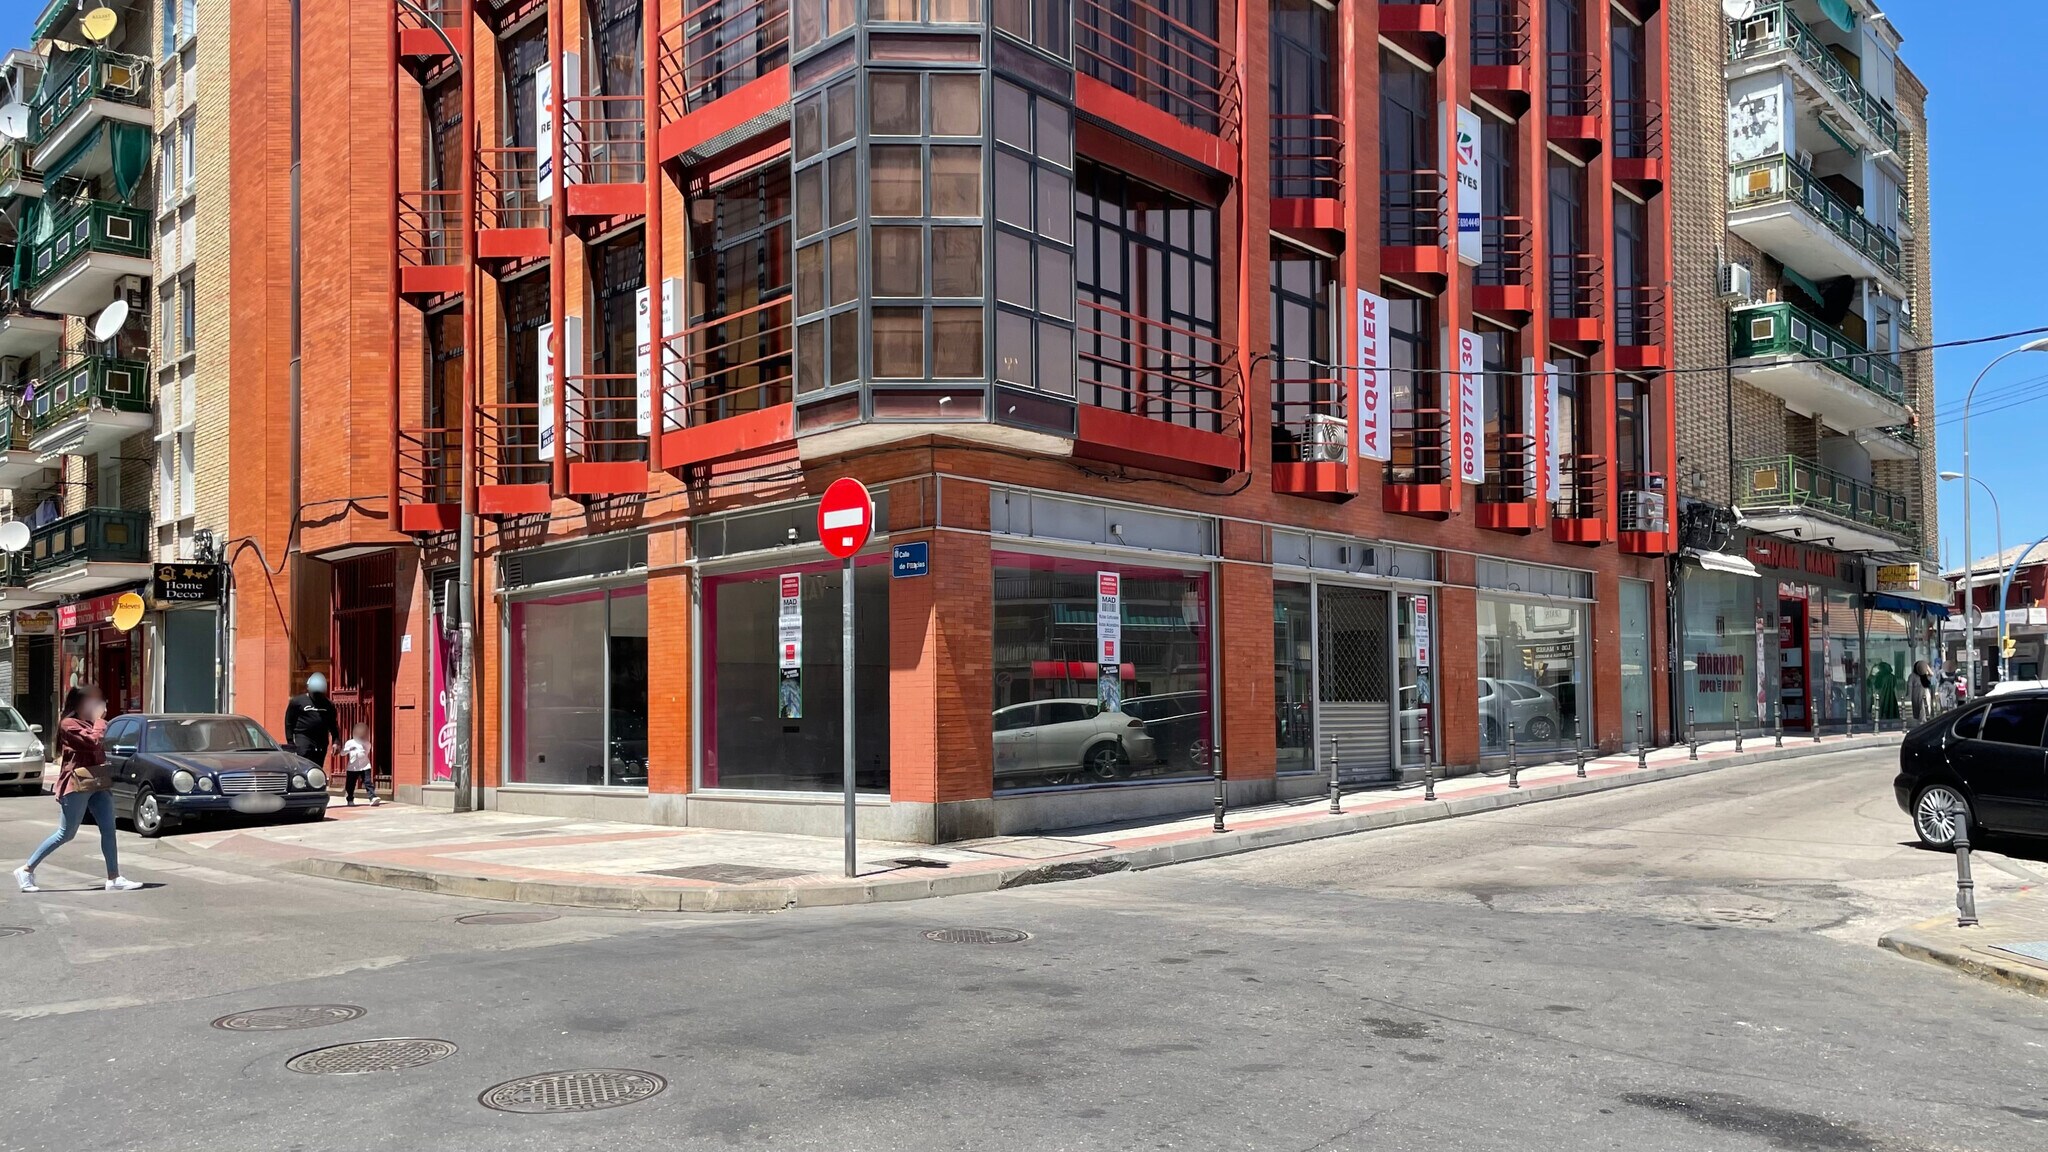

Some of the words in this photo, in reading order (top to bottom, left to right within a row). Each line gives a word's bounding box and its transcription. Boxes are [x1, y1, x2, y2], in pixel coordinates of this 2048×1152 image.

[1457, 171, 1478, 190] EYES
[1462, 337, 1473, 366] 30
[1363, 297, 1378, 451] ALQUILER
[1463, 400, 1474, 428] 77
[1463, 431, 1474, 475] 609
[166, 581, 203, 590] Home
[166, 590, 204, 598] Decor
[118, 602, 141, 610] Televes
[783, 598, 798, 606] MAD
[1697, 652, 1744, 675] MARHABA
